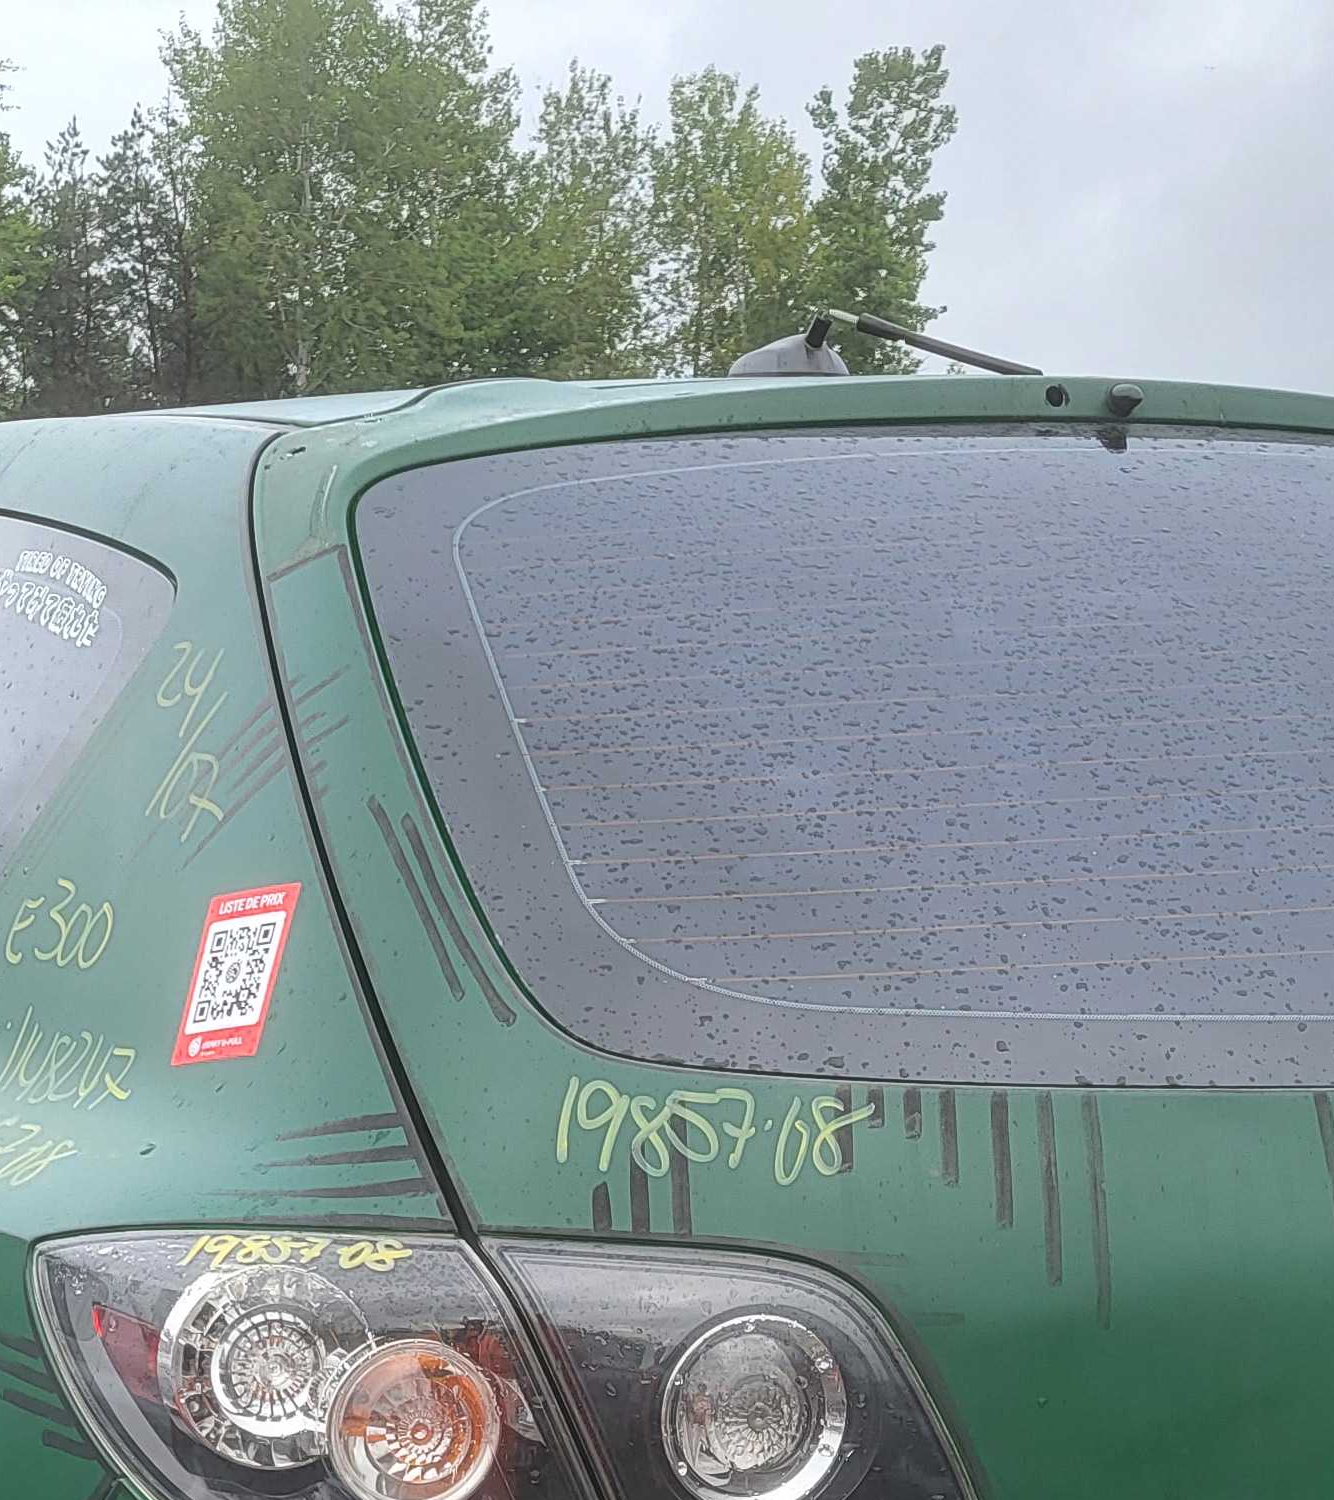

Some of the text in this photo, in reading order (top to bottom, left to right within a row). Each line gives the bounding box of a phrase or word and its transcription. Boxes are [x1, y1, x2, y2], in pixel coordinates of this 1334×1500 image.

[219, 891, 287, 915] LISTE DE PRIX
